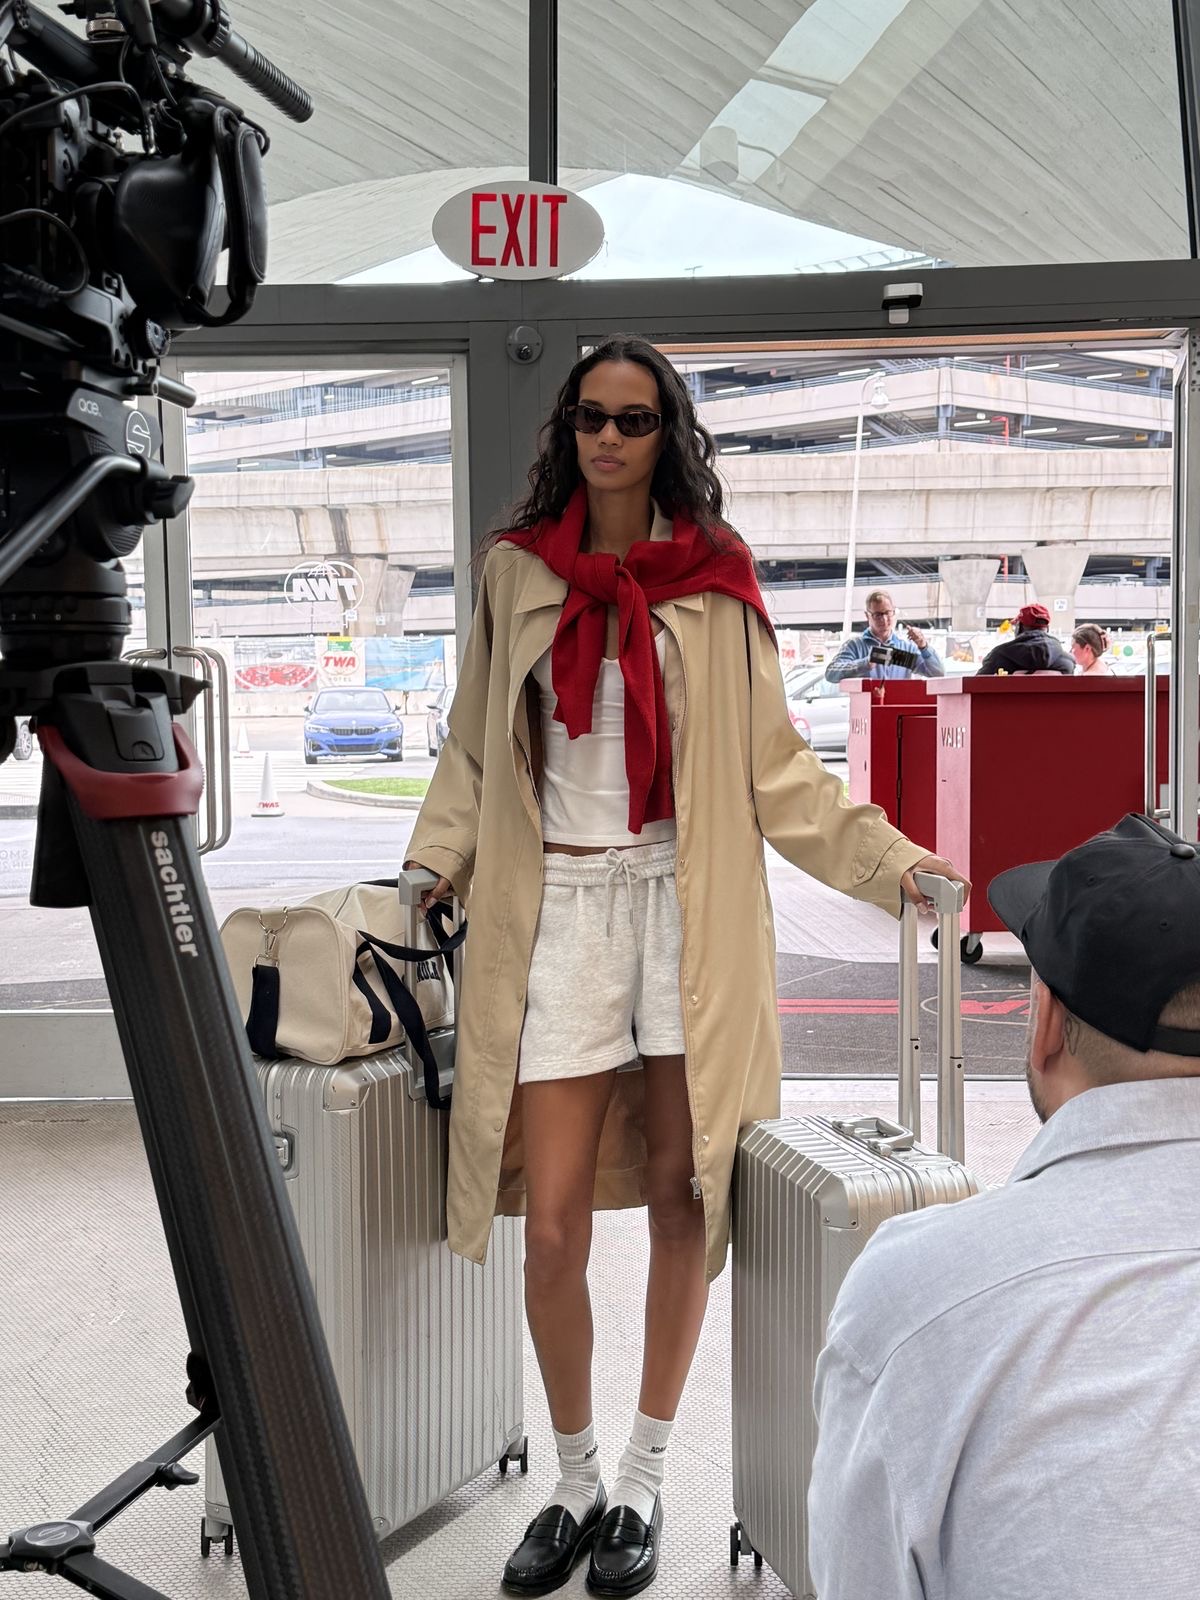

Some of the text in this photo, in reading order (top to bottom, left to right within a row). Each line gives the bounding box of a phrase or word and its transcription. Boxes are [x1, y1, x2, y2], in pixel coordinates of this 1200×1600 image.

[471, 192, 568, 268] EXIT
[323, 656, 356, 669] TWA
[941, 727, 966, 748] VALET
[150, 831, 198, 957] sachtler
